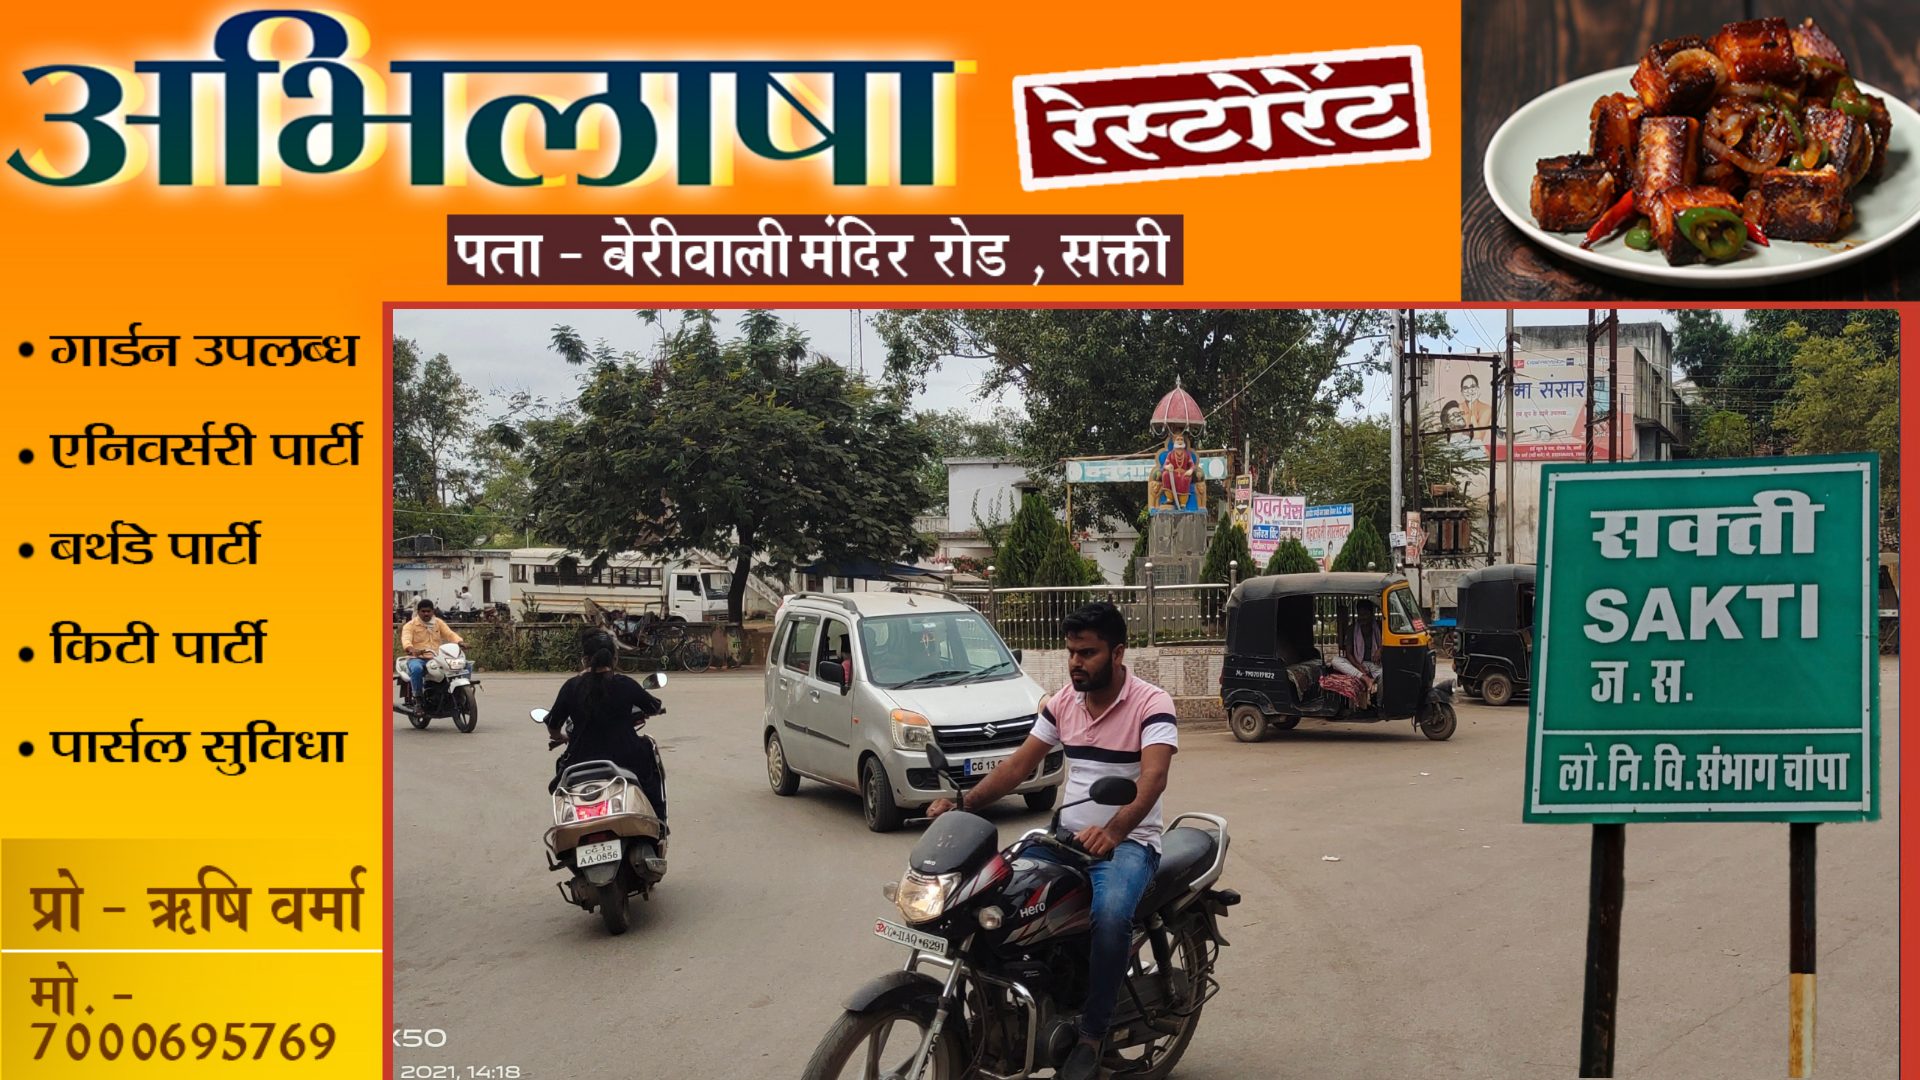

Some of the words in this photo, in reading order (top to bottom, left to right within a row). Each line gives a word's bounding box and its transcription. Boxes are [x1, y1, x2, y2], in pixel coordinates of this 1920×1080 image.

[1538, 372, 1586, 400] संसार
[1590, 489, 1826, 560] सक्ती
[1583, 584, 1819, 644] SAKTI
[971, 762, 984, 771] CG
[986, 760, 996, 770] 13
[1783, 745, 1850, 791] चांपा
[580, 850, 618, 865] AA-0856
[1019, 902, 1046, 918] Hero
